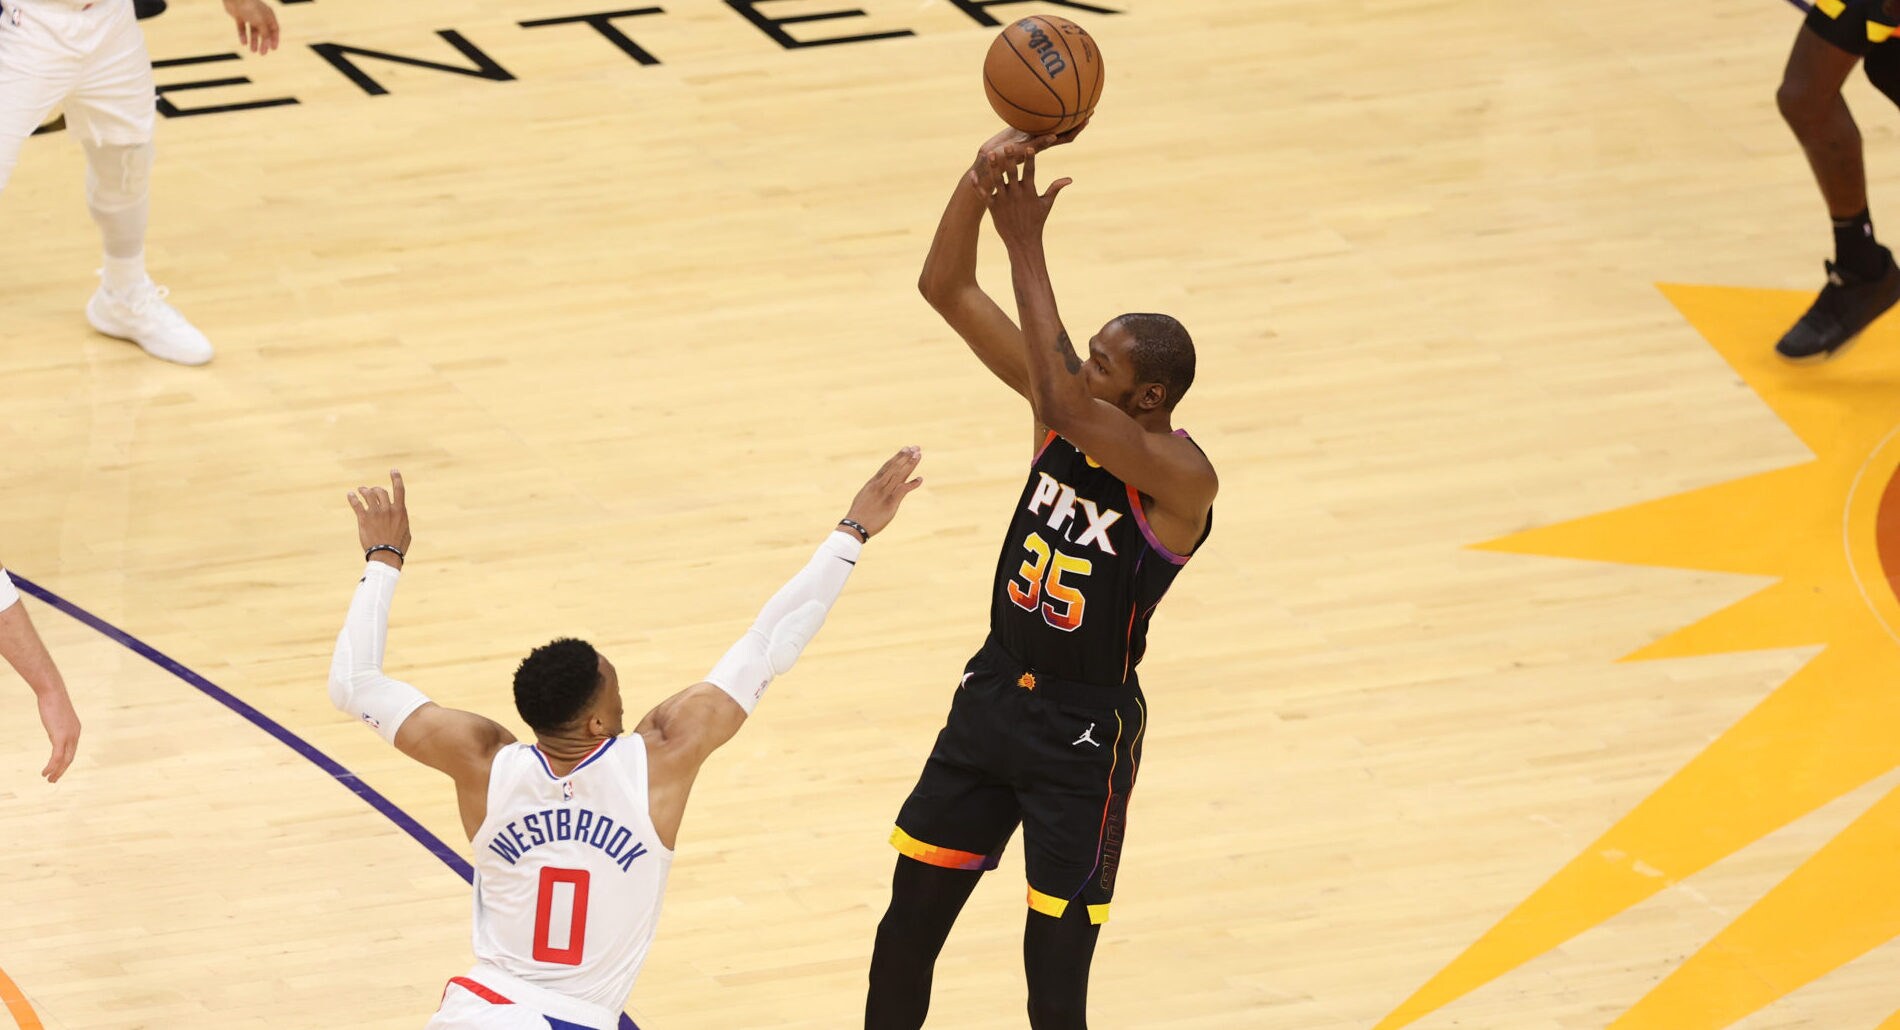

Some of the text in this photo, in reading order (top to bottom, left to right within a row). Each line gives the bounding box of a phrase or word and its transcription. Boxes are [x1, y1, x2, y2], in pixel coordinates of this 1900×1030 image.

[1017, 18, 1066, 79] Wilson
[1007, 532, 1092, 632] 35
[488, 808, 648, 873] WESTBROOK
[532, 866, 590, 966] 0
